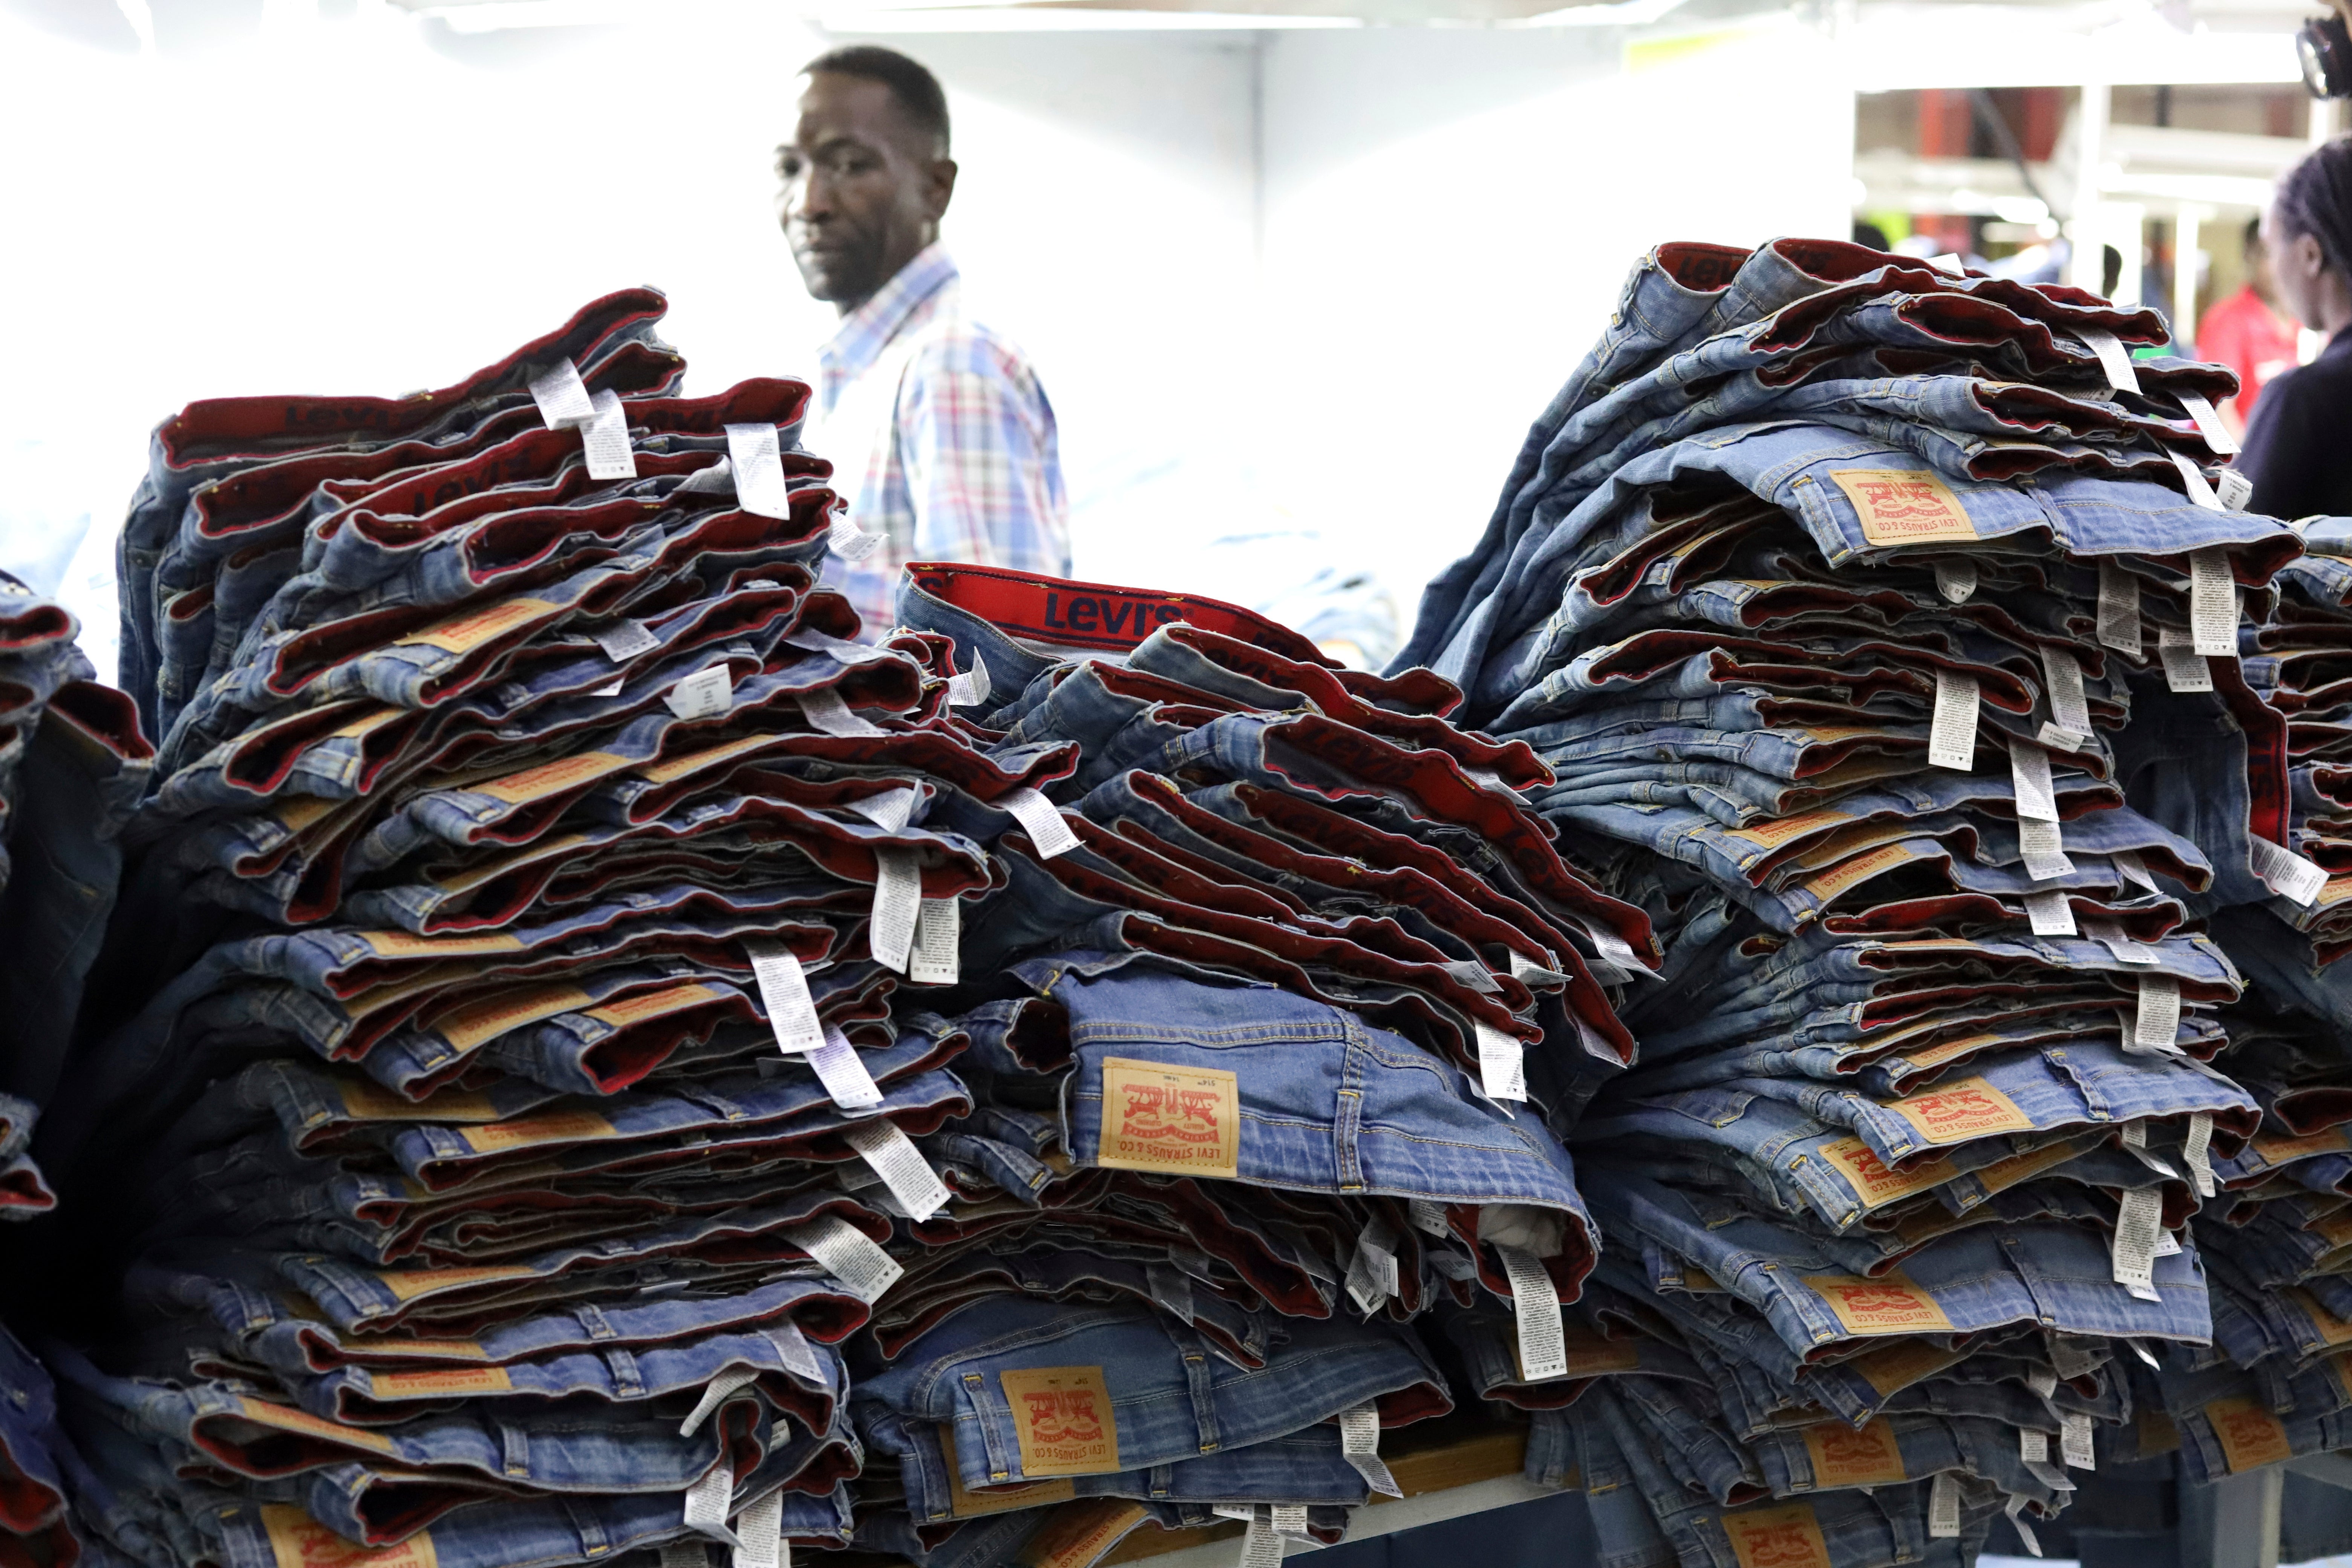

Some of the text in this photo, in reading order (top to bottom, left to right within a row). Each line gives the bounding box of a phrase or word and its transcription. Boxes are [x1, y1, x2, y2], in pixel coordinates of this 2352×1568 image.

[1875, 522, 1891, 531] CO.
[1900, 520, 1938, 531] STRAUSS
[1939, 518, 1959, 527] LEVI
[1875, 851, 1893, 860] LEVI
[1842, 859, 1875, 876] STRAUSS
[1821, 878, 1836, 886] CO.
[1954, 1118, 1991, 1129] STRAUSS
[1994, 1115, 2013, 1124] LEVI
[1117, 1141, 1220, 1159] LEVI STRAUSS & CO.
[1869, 1184, 1882, 1192] CO.
[1876, 1313, 1911, 1322] STRAUSS
[1033, 1444, 1106, 1460] LEVI STRAUSS & CO.
